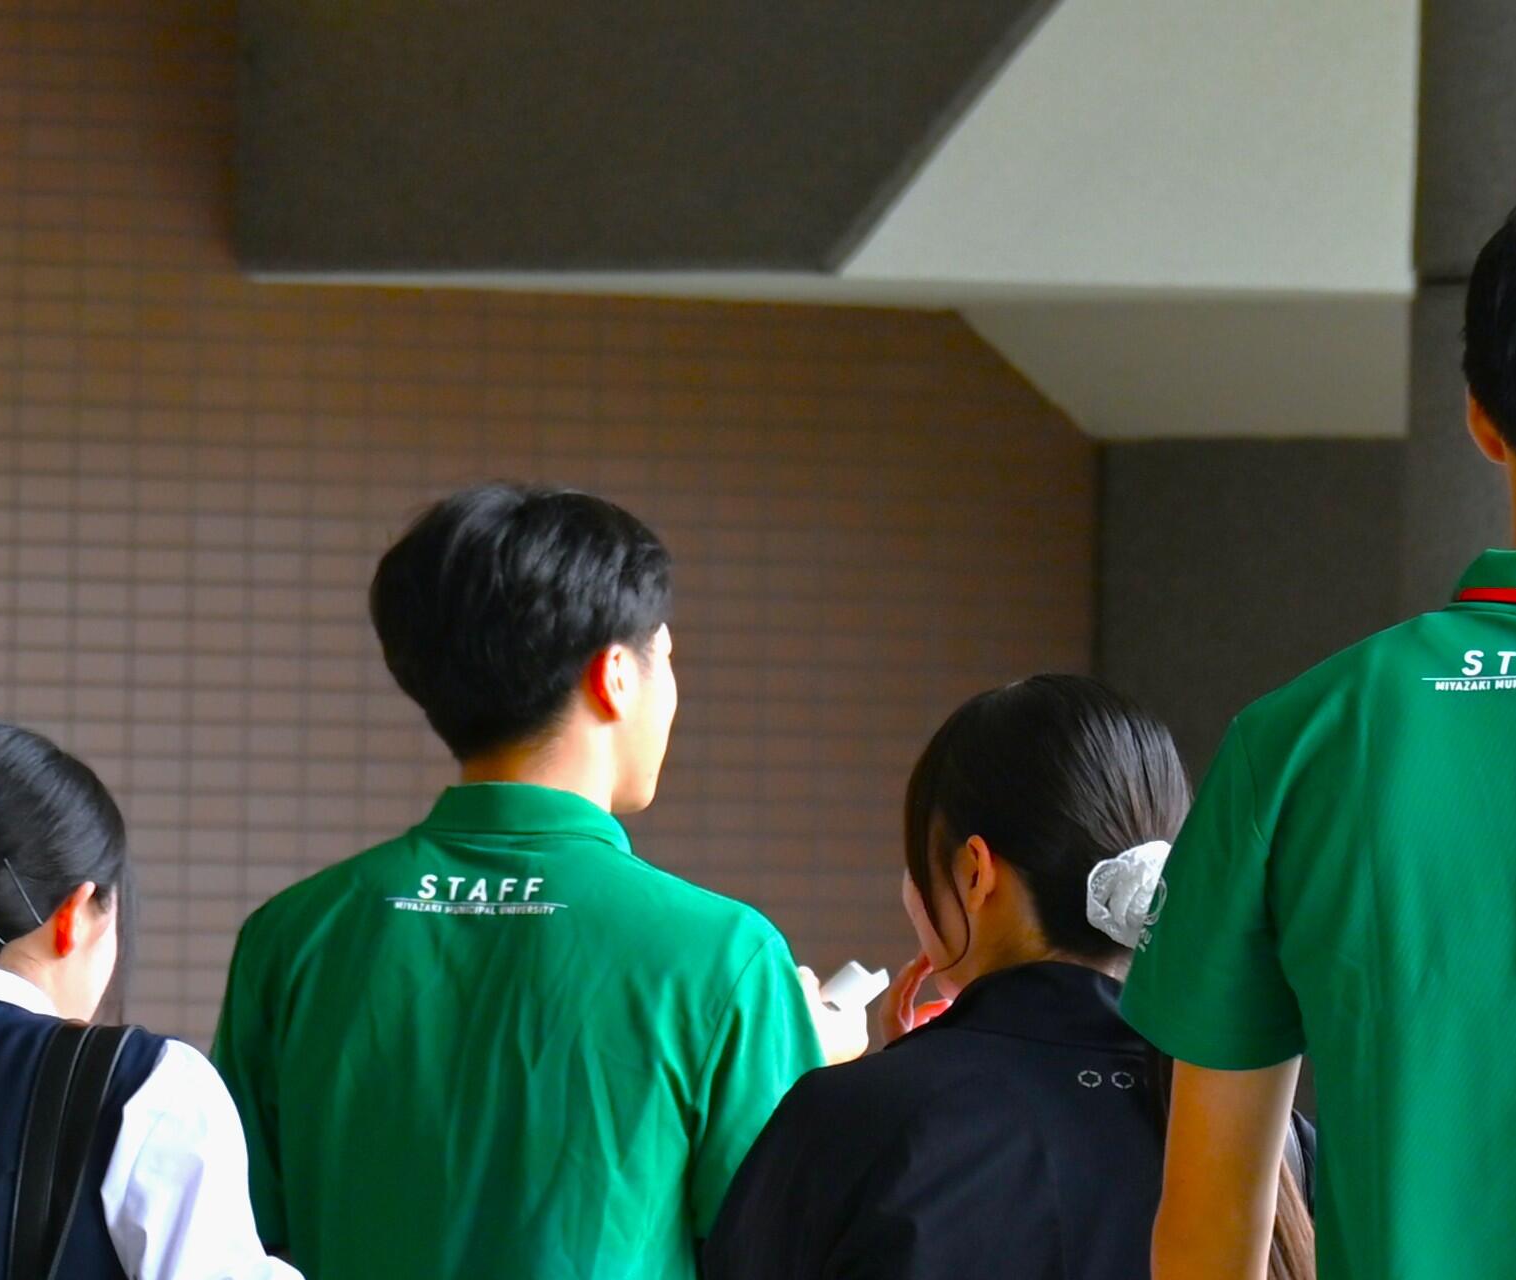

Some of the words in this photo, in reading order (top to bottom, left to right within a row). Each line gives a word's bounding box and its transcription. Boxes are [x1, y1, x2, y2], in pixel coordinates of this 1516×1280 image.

[1434, 679, 1491, 691] MIYAZAKI
[417, 873, 544, 902] STAFF
[393, 901, 442, 914] MIYAZAKI
[444, 903, 496, 916] MUNICIPAL
[498, 906, 556, 916] UNIVERSITY
